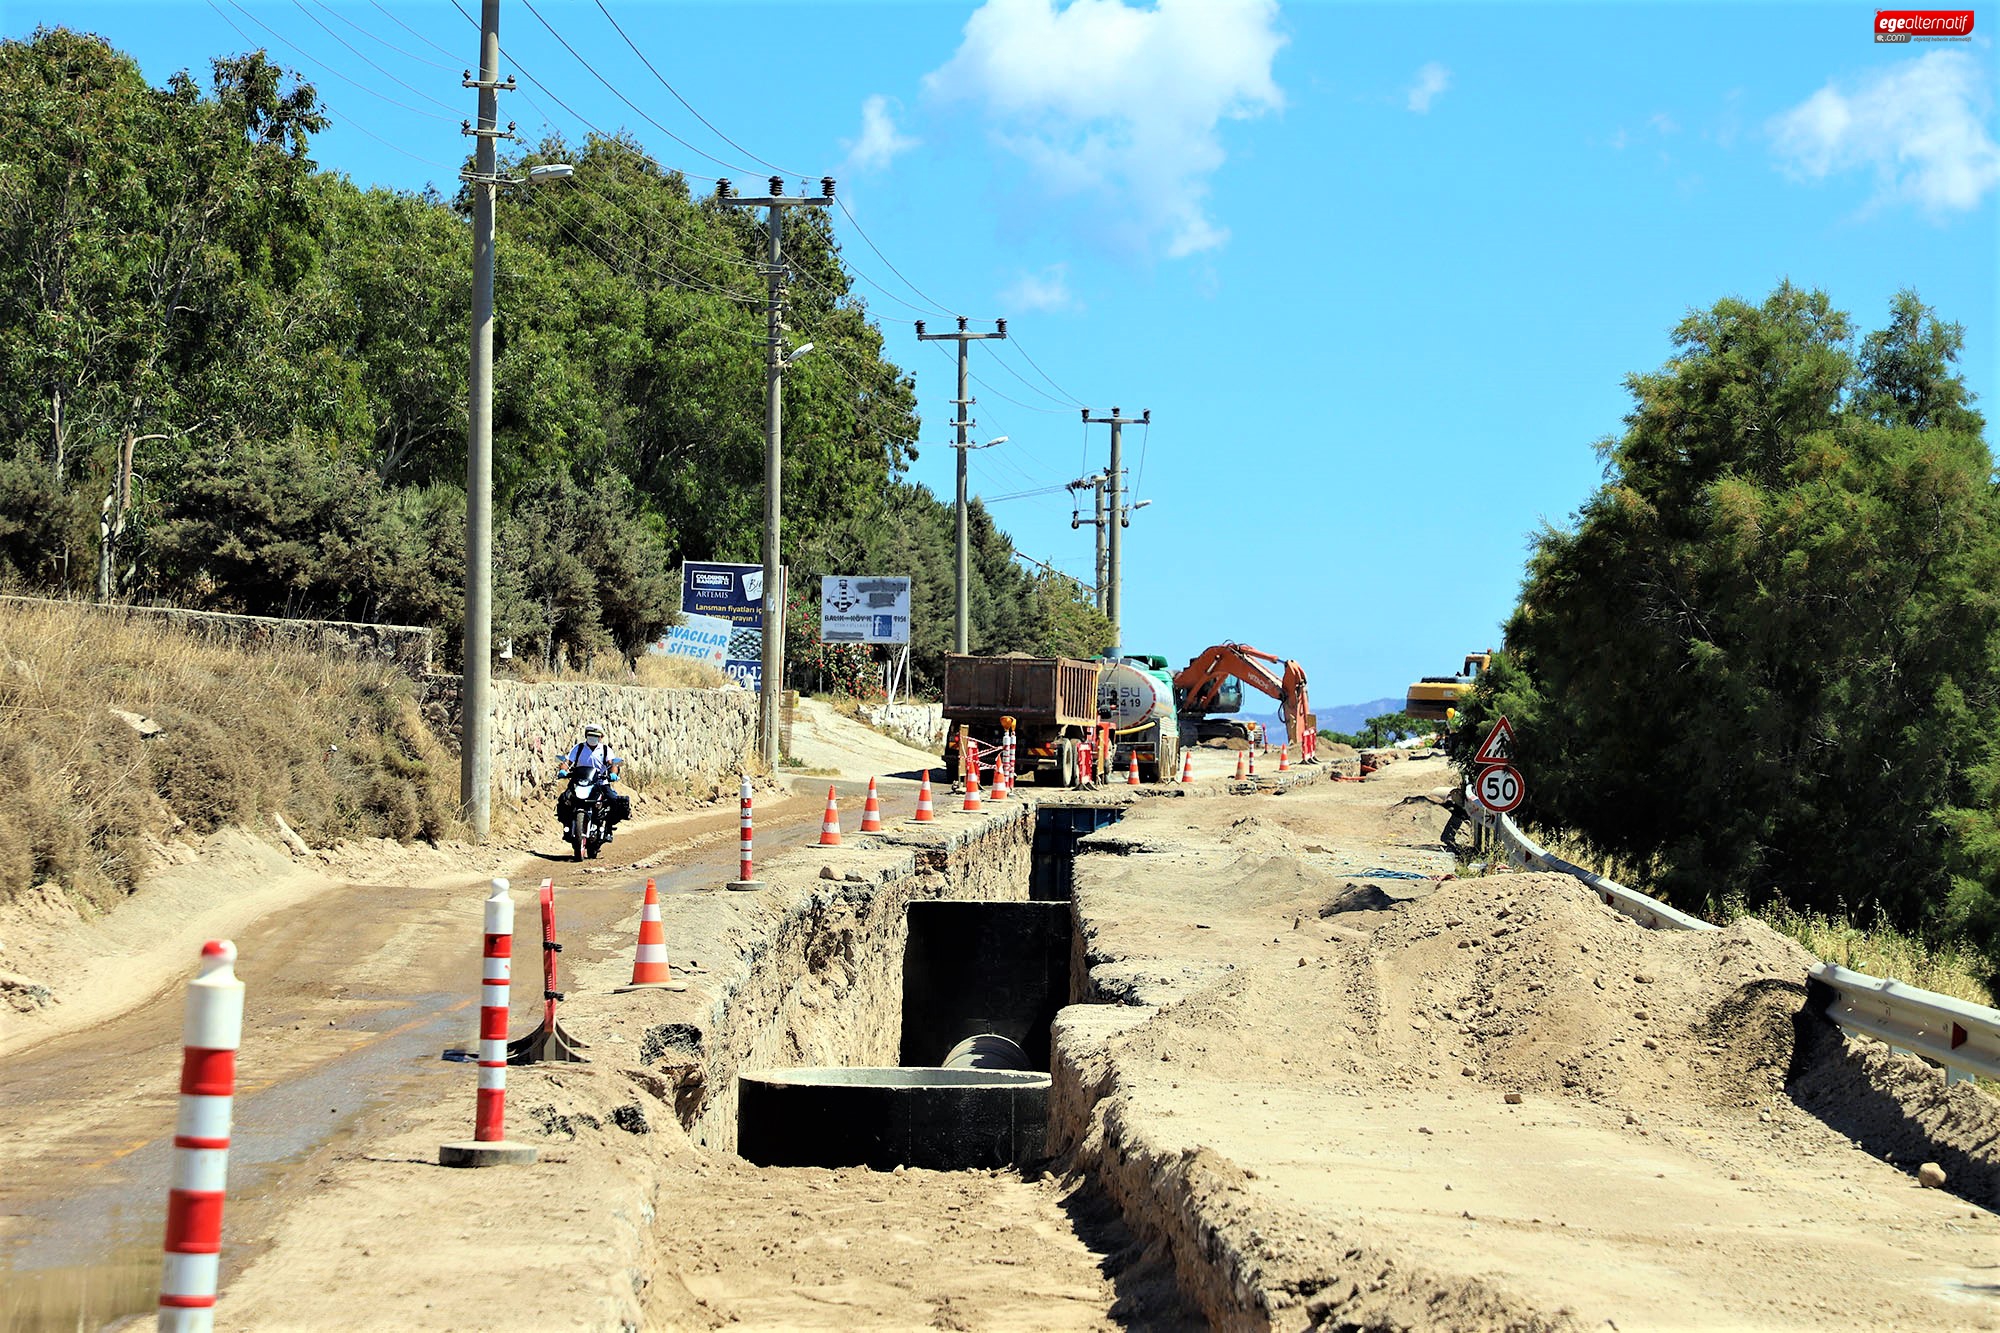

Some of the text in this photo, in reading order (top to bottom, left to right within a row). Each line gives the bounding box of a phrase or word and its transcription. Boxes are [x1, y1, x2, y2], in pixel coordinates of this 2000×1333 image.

[696, 603, 726, 611] Lansman
[728, 605, 755, 613] fiyatları
[731, 614, 753, 623] arayın
[668, 626, 727, 648] AVACILAR
[668, 641, 710, 659] SİTESİ
[1120, 687, 1140, 697] SU
[1130, 698, 1141, 708] 19
[1487, 778, 1516, 801] 50
